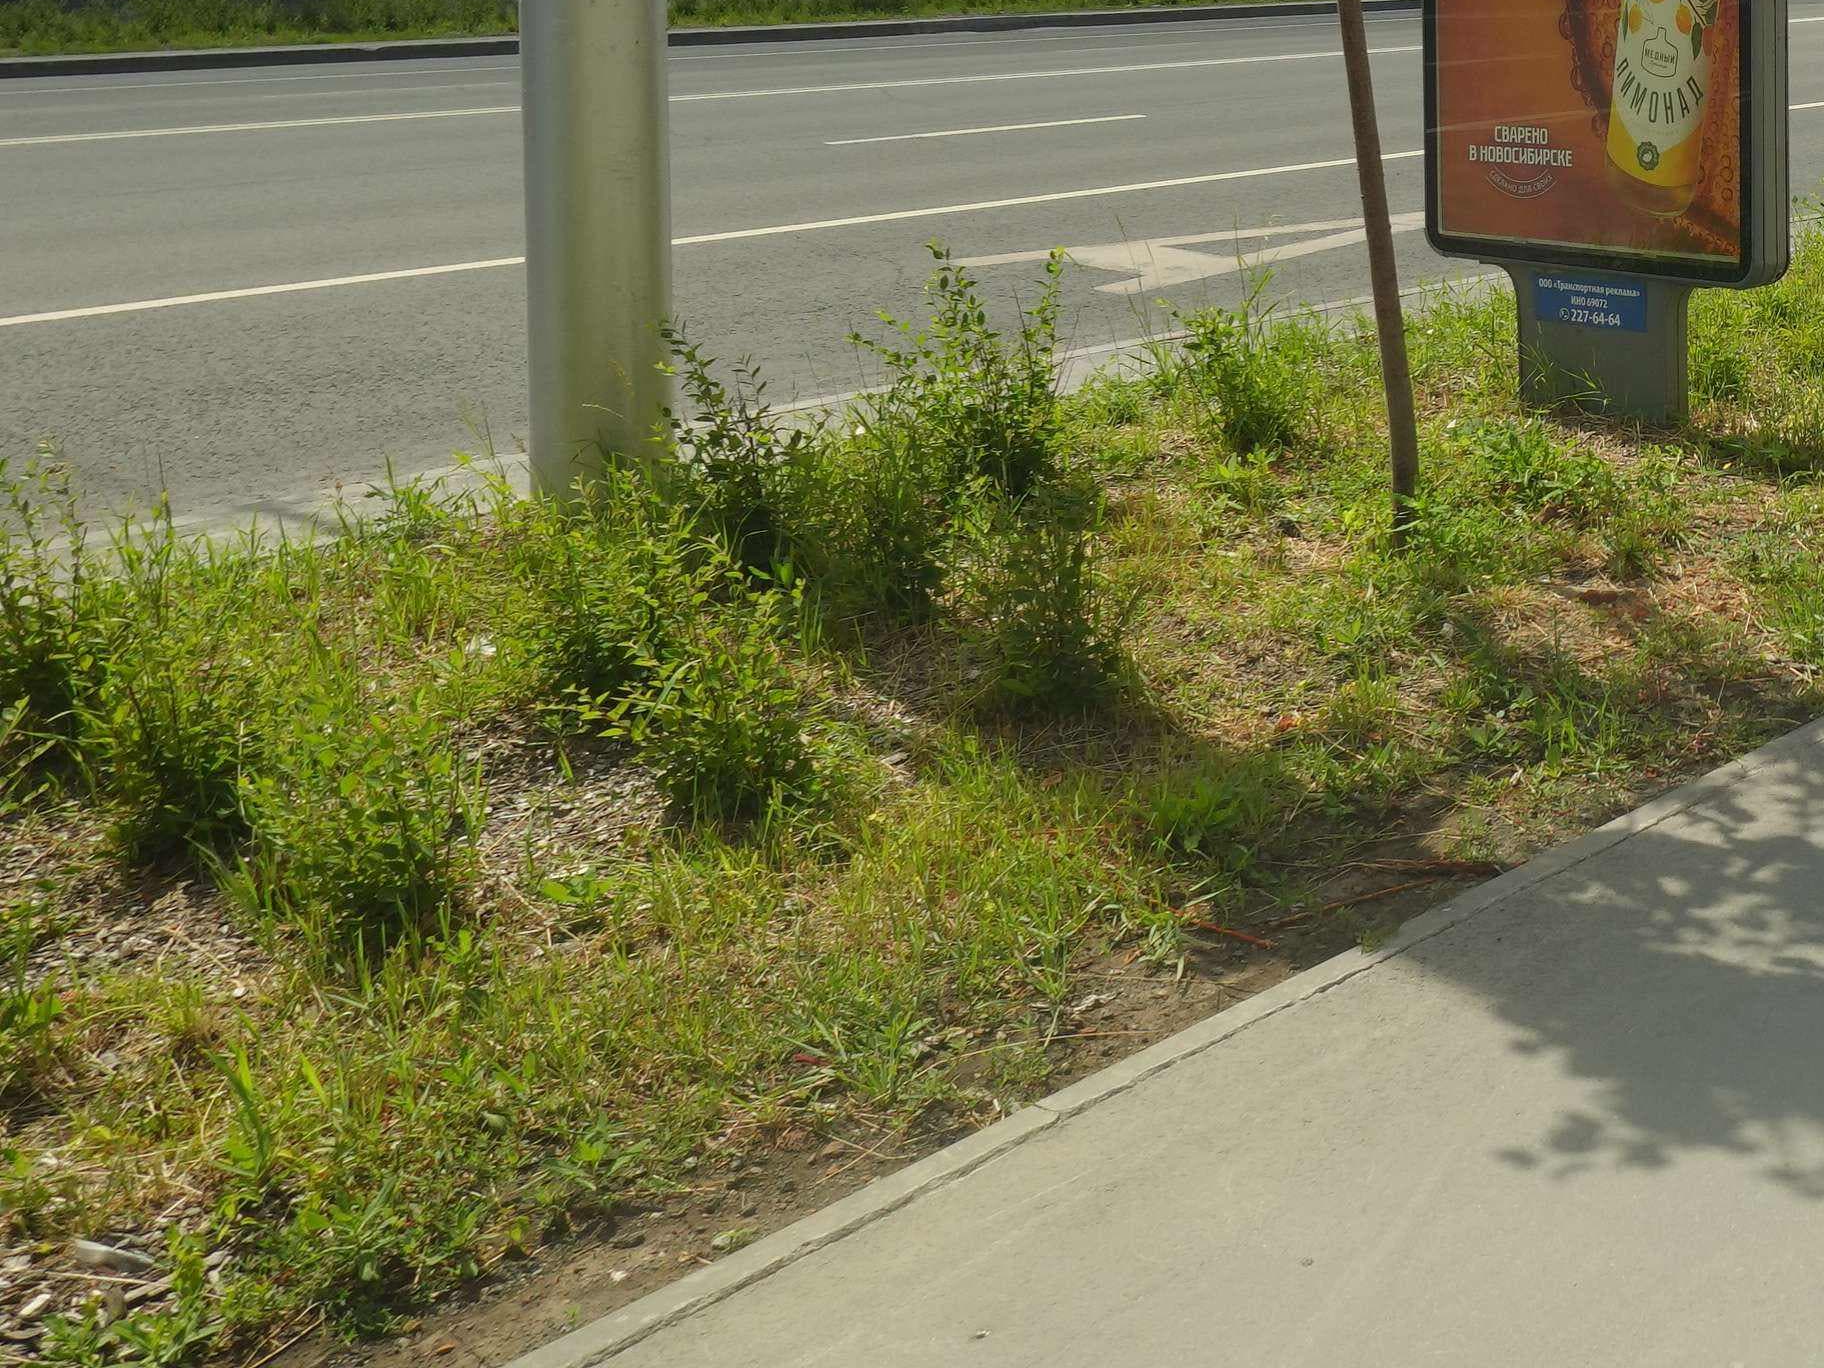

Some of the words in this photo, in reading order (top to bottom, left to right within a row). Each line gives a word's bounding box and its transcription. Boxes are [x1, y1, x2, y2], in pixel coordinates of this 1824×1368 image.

[1616, 58, 1704, 124] ЛИМОНАД
[1494, 125, 1548, 144] СВАРЕНО
[1469, 145, 1477, 160] В
[1480, 145, 1573, 167] НОВОСИБИРСКЕ
[1538, 278, 1552, 288] ООО
[1570, 309, 1621, 327] 227-64-64
